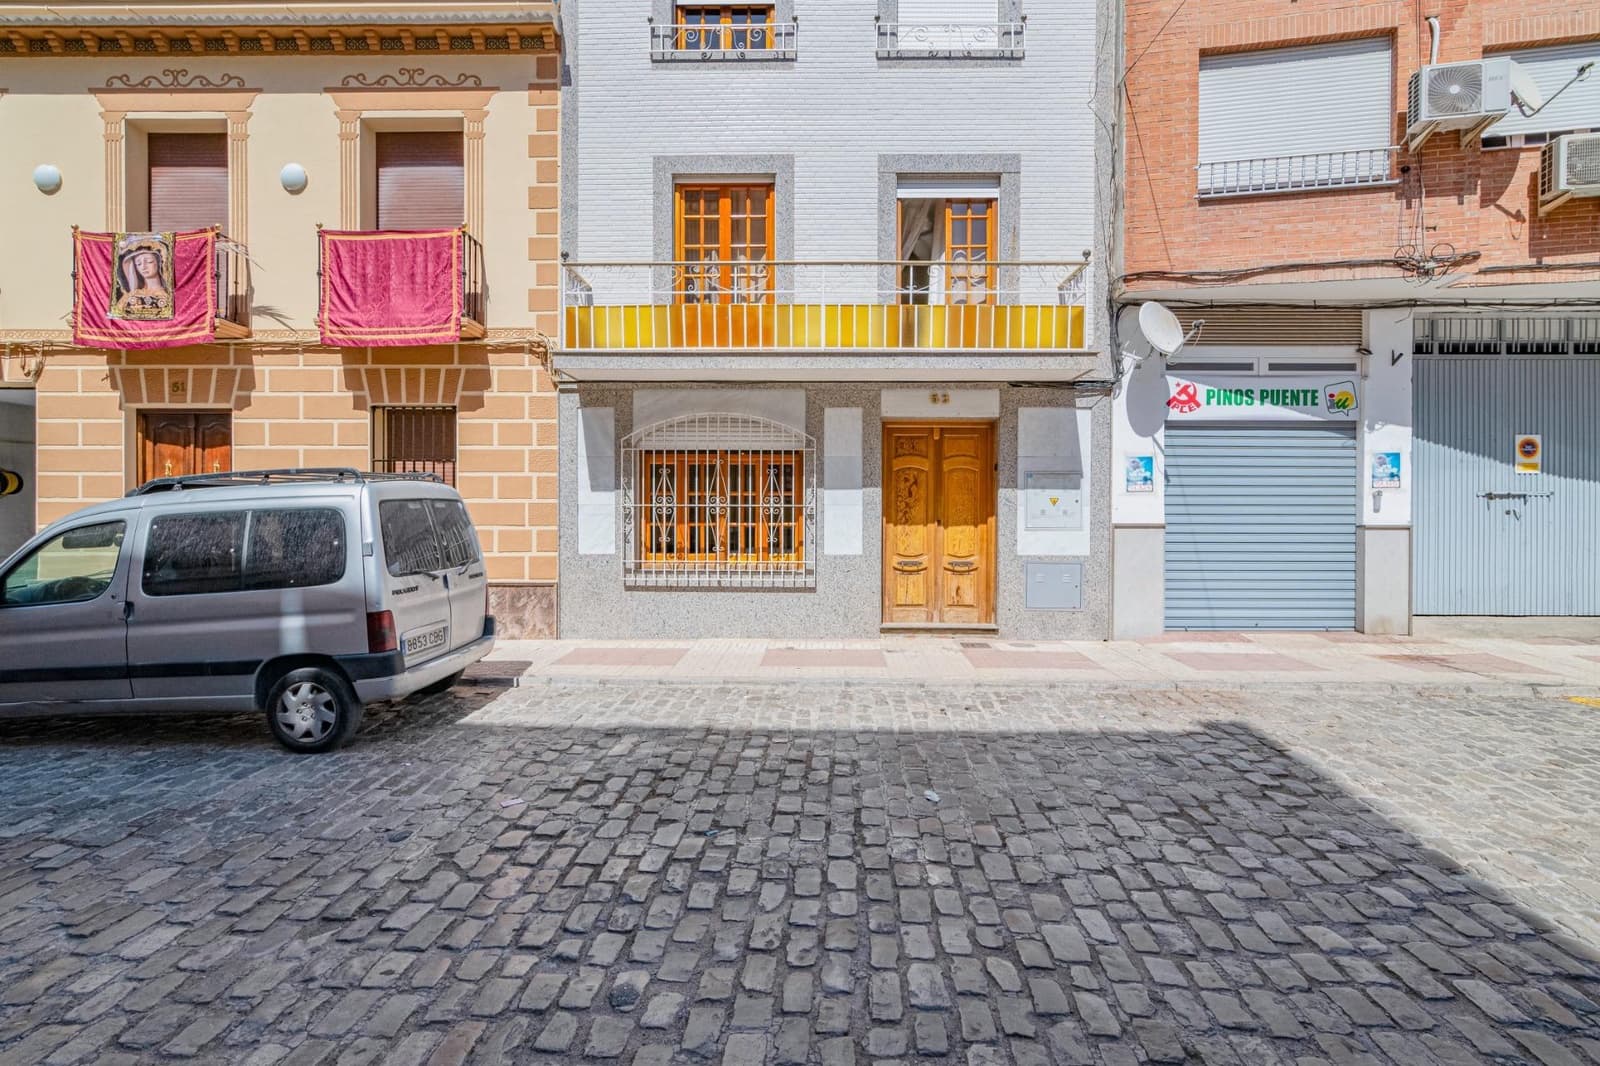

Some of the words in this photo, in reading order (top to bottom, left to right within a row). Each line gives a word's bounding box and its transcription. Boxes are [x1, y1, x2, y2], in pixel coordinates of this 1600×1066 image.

[171, 382, 185, 393] 51
[1206, 388, 1256, 407] PINOS
[1259, 388, 1319, 407] PUENTE
[1171, 402, 1198, 414] PCE
